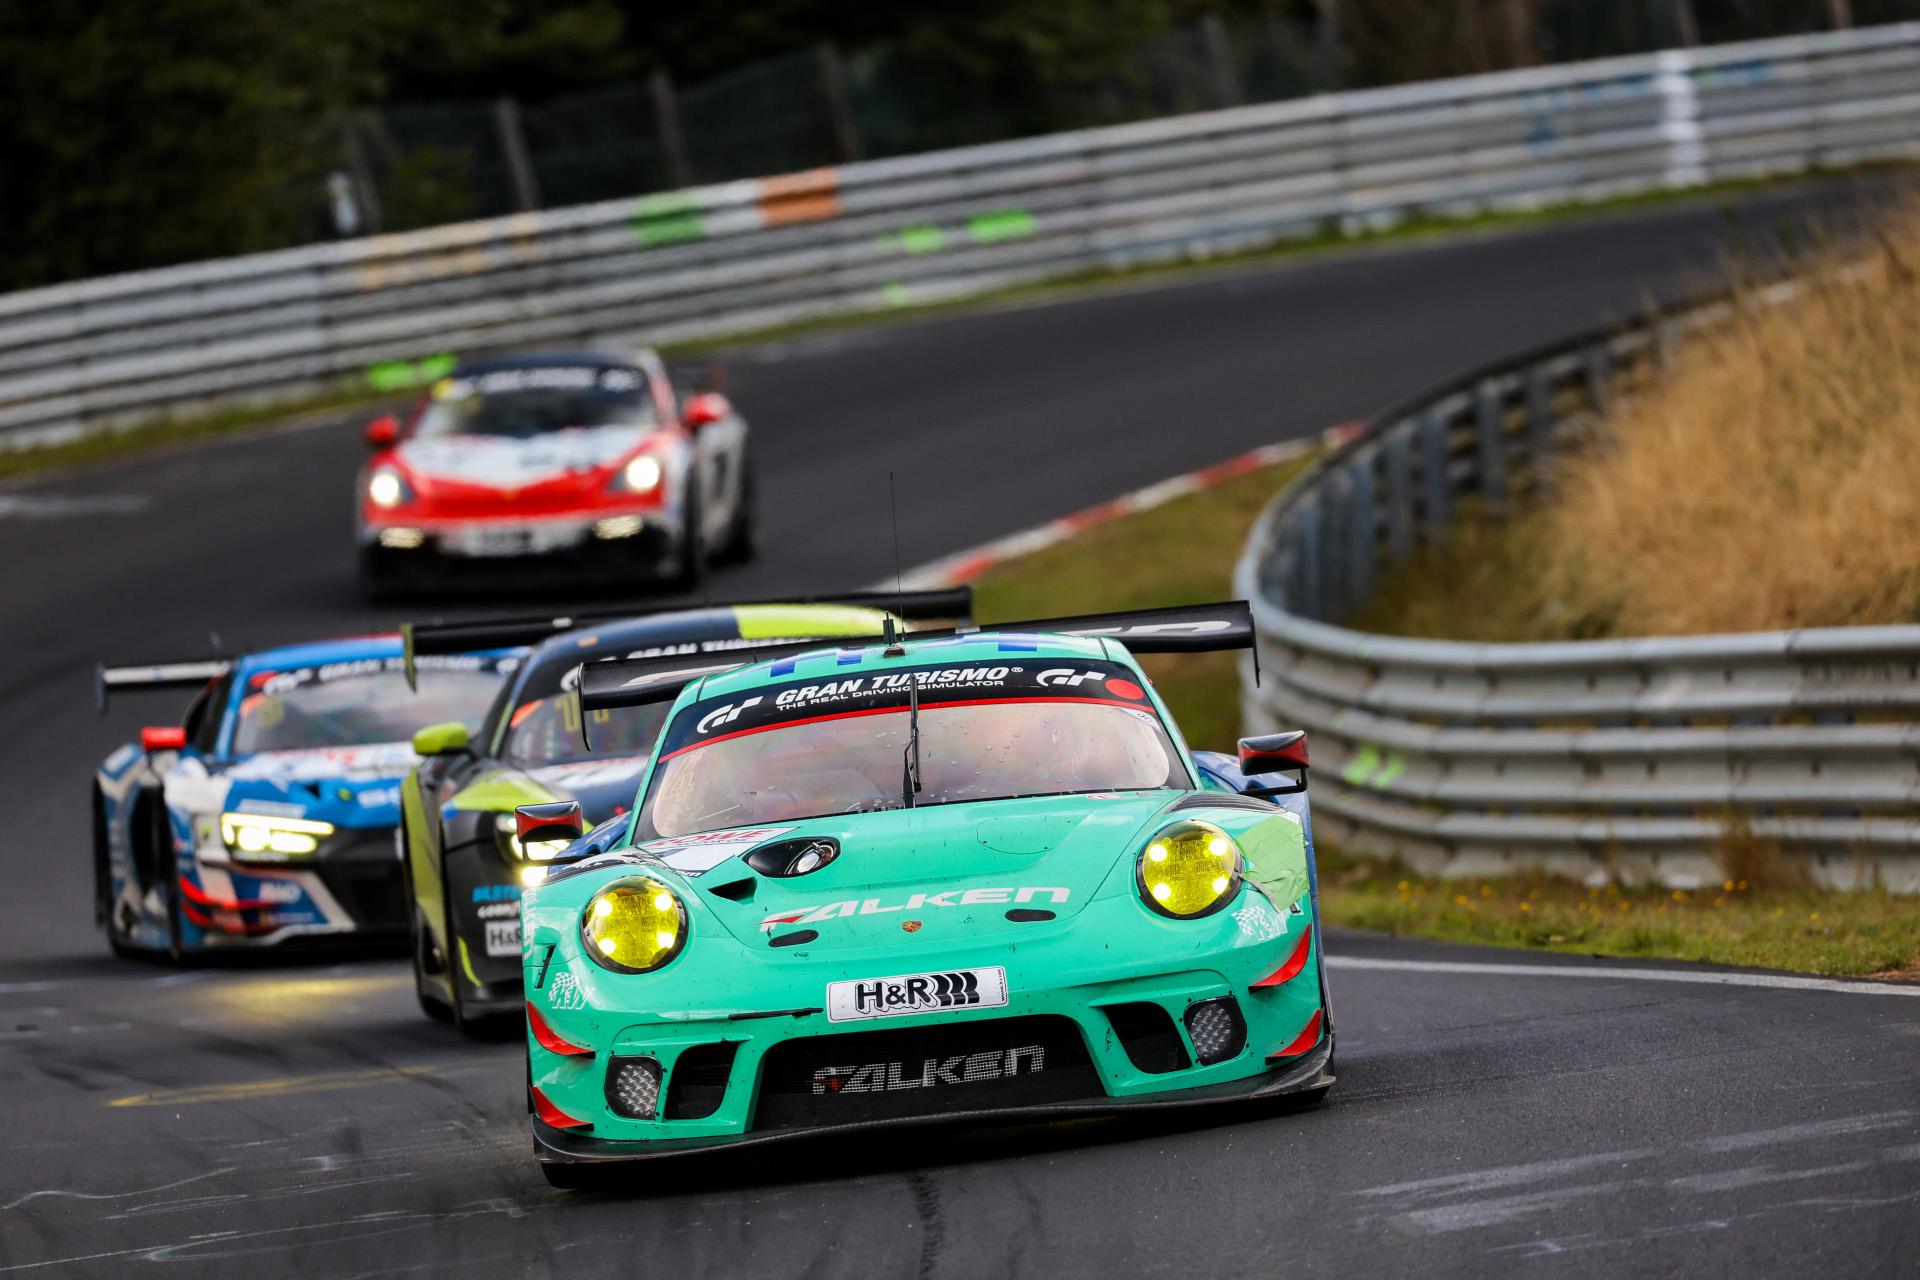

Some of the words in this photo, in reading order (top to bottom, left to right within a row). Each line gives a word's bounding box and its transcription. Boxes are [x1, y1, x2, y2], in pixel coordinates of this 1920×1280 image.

[775, 679, 864, 705] GRAN
[777, 700, 806, 712] THE
[810, 694, 849, 705] REAL
[852, 685, 911, 698] DRIVING
[917, 681, 1004, 691] SIMULATOR
[754, 887, 1071, 932] FALKEN
[855, 977, 931, 1013] H&R
[808, 1045, 1045, 1095] FALKEN
